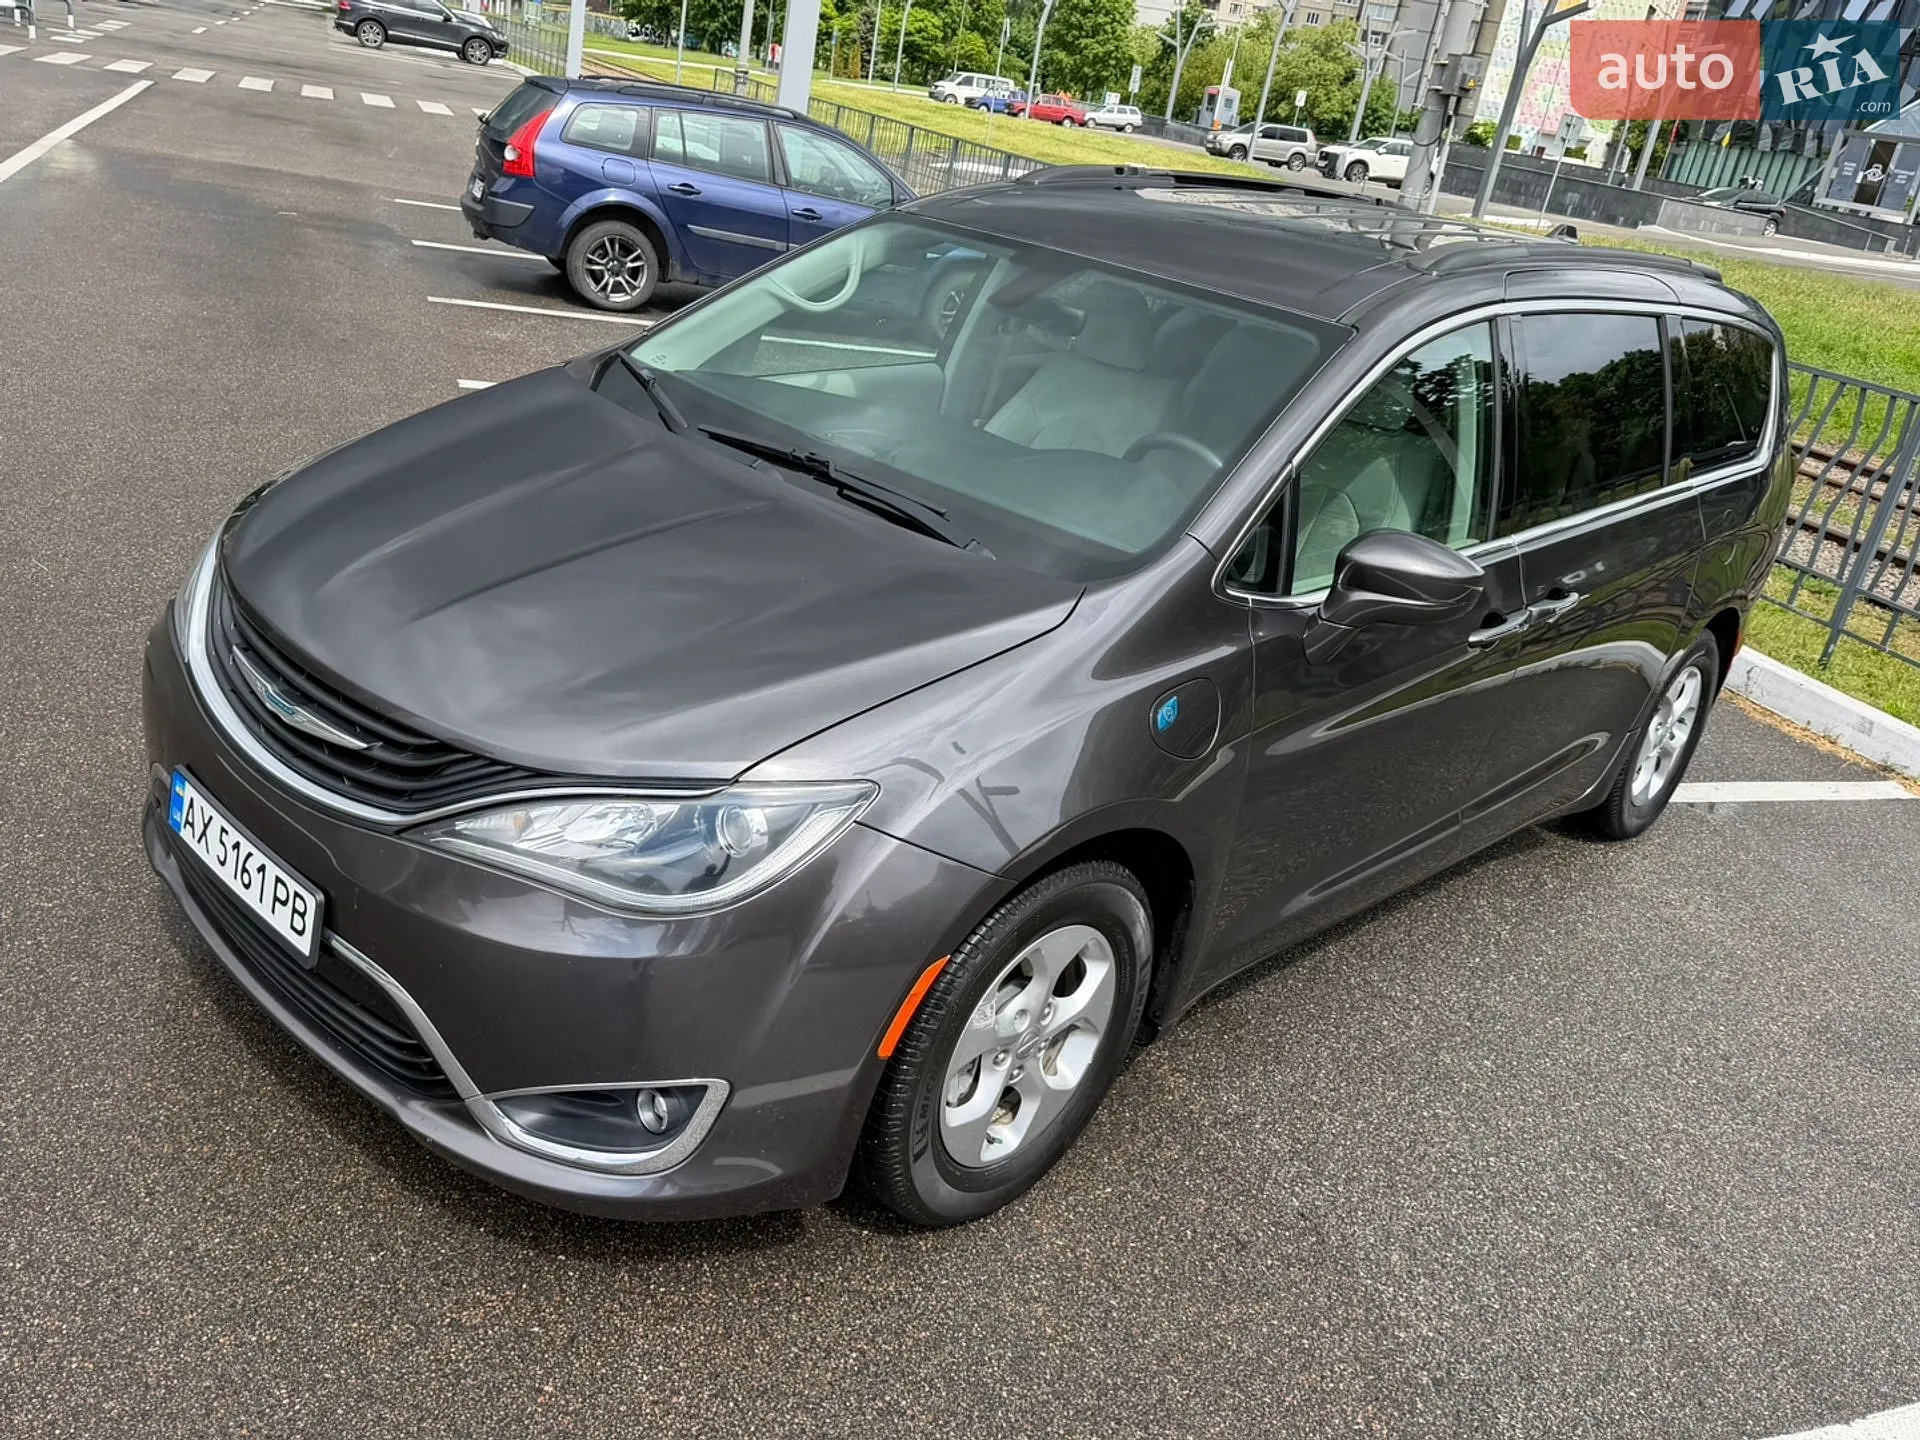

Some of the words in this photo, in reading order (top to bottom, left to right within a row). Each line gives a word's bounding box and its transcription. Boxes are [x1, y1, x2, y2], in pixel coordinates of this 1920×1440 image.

[183, 797, 213, 855] AX
[216, 826, 266, 905] 5161
[271, 875, 309, 937] PB
